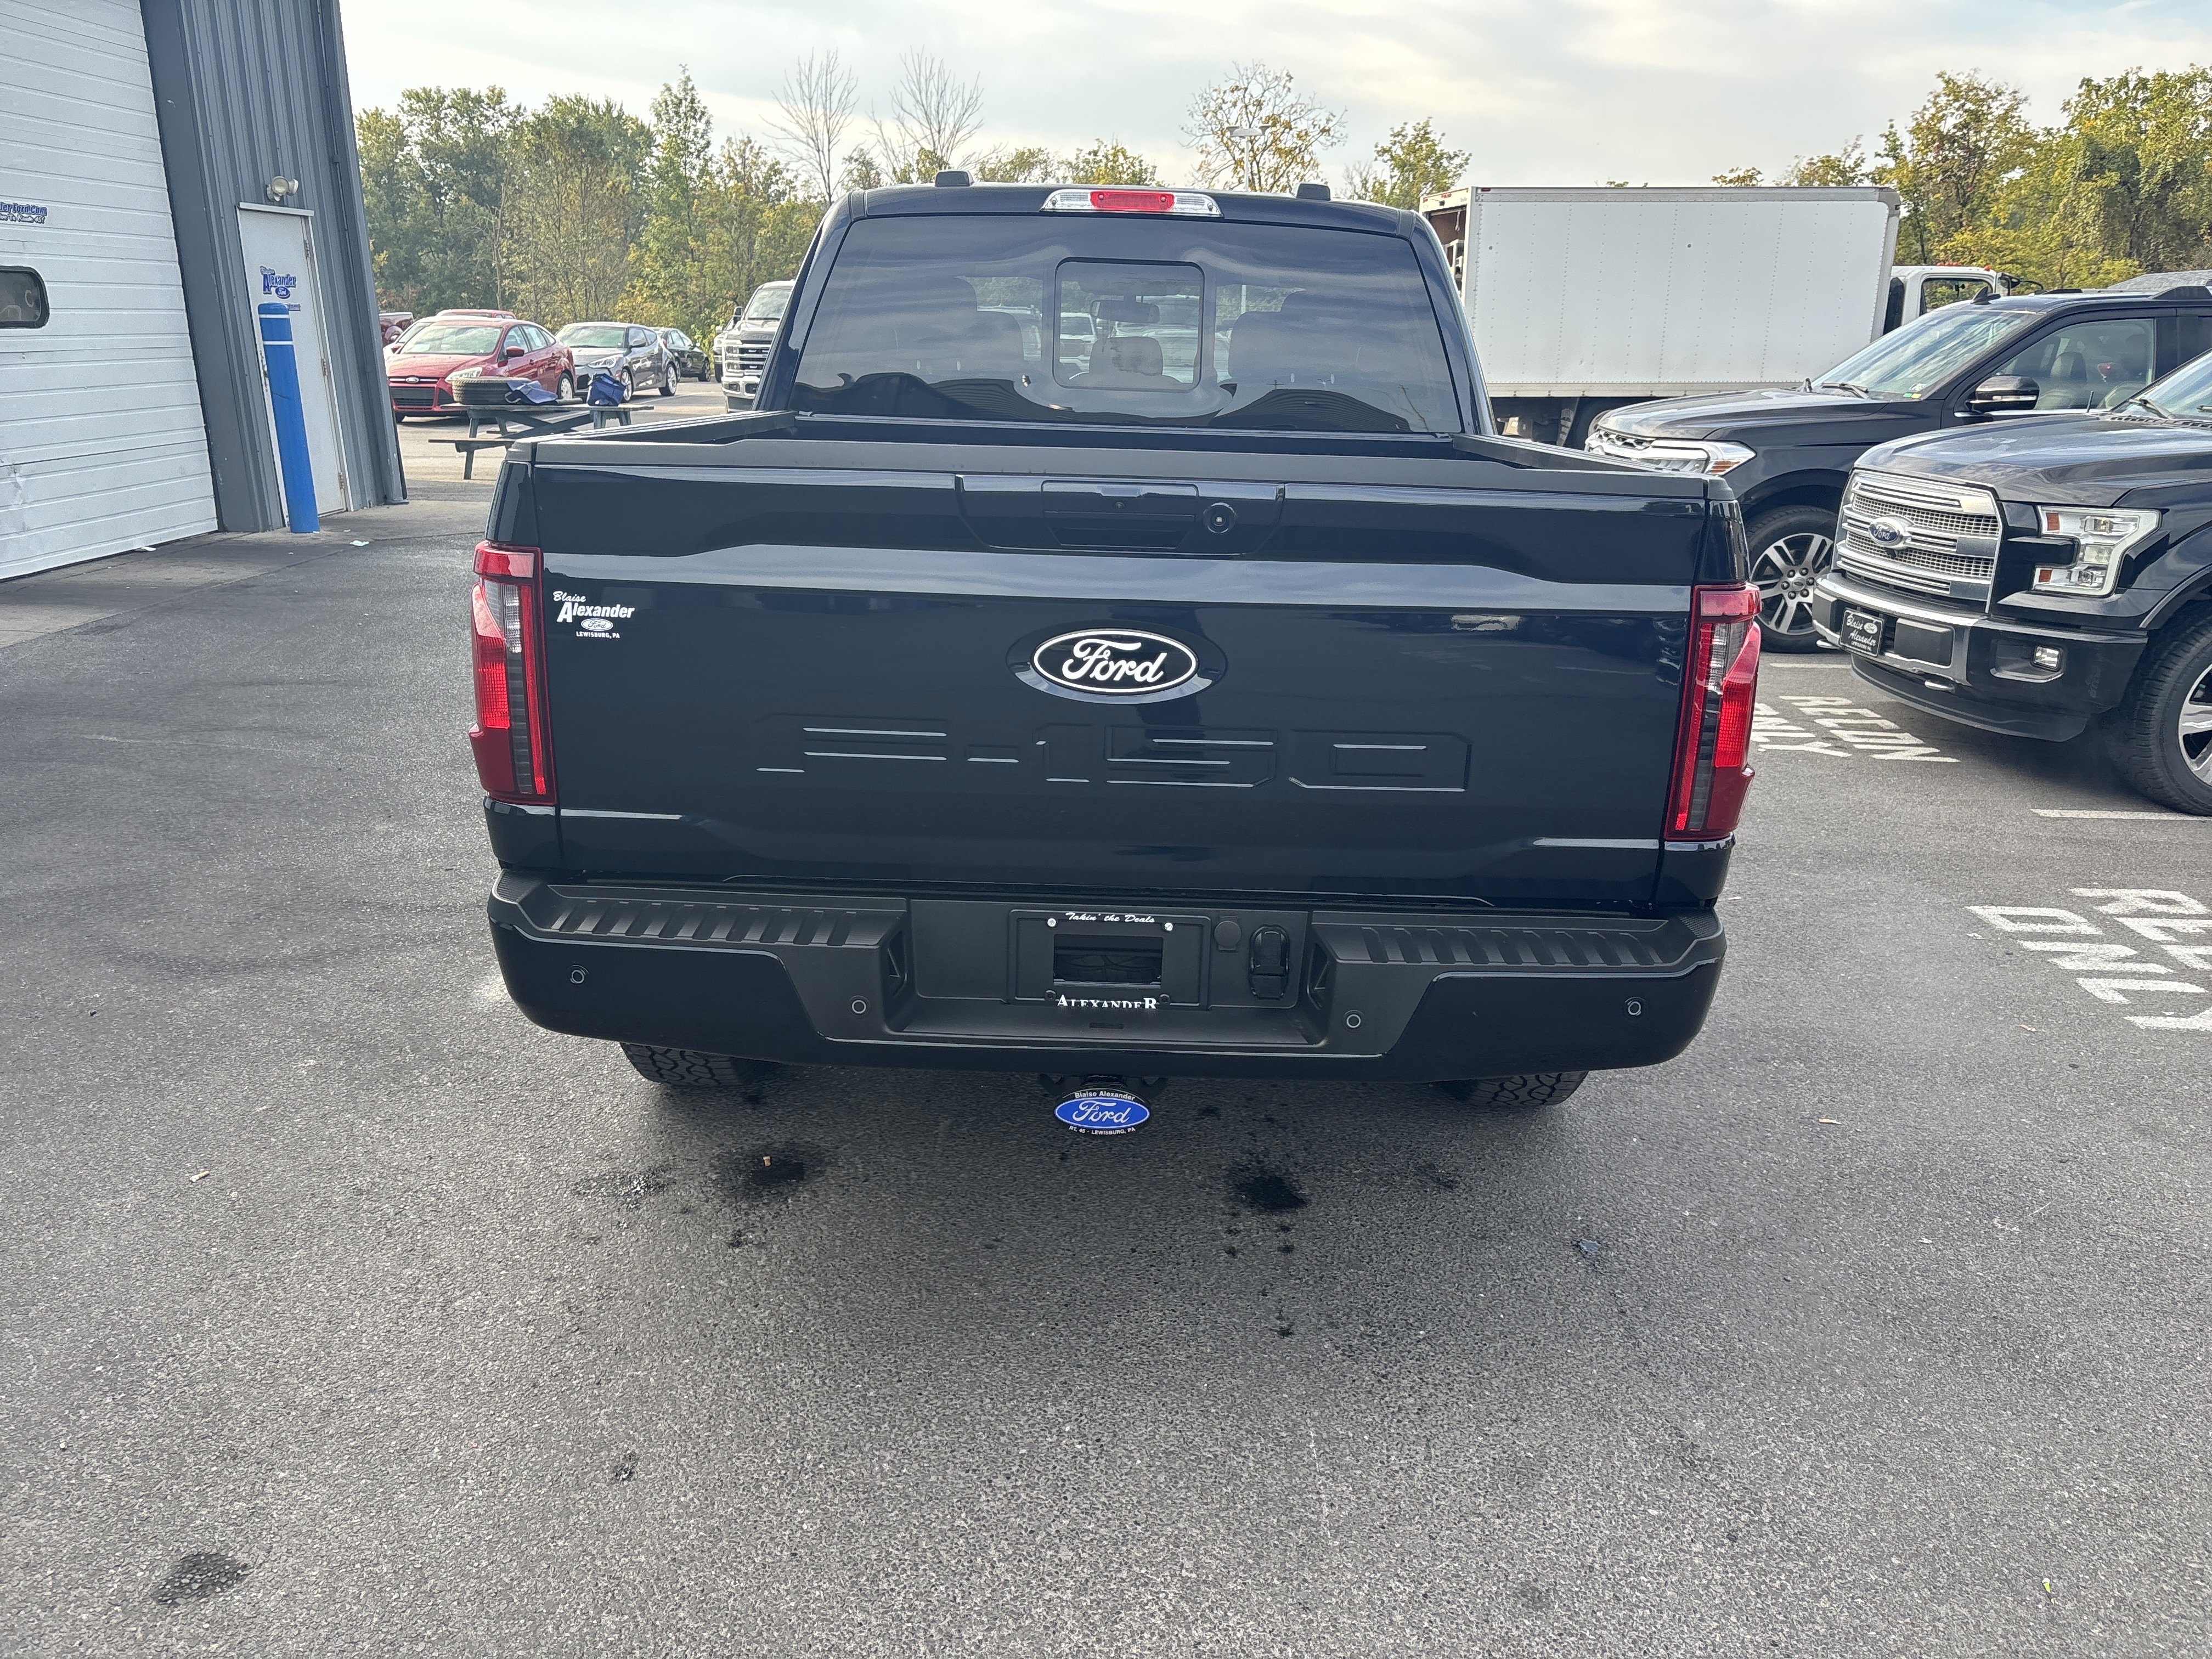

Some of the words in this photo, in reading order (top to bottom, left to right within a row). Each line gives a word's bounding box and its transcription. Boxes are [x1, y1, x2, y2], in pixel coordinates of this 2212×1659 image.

[263, 274, 296, 294] Alexander
[1874, 524, 1891, 540] Ford
[552, 590, 586, 602] Blaise
[556, 601, 635, 623] Alexander
[588, 620, 606, 629] Ford
[1846, 614, 1864, 630] Blaise
[1848, 629, 1876, 647] Alexander
[1062, 639, 1167, 682] Ford
[1779, 696, 1961, 763] RECON
[1065, 912, 1101, 921] Takin'
[1124, 914, 1155, 923] Deals
[1057, 994, 1157, 1009] ALEXANDER
[1099, 1091, 1136, 1101] Alexander
[1073, 1100, 1132, 1124] Ford
